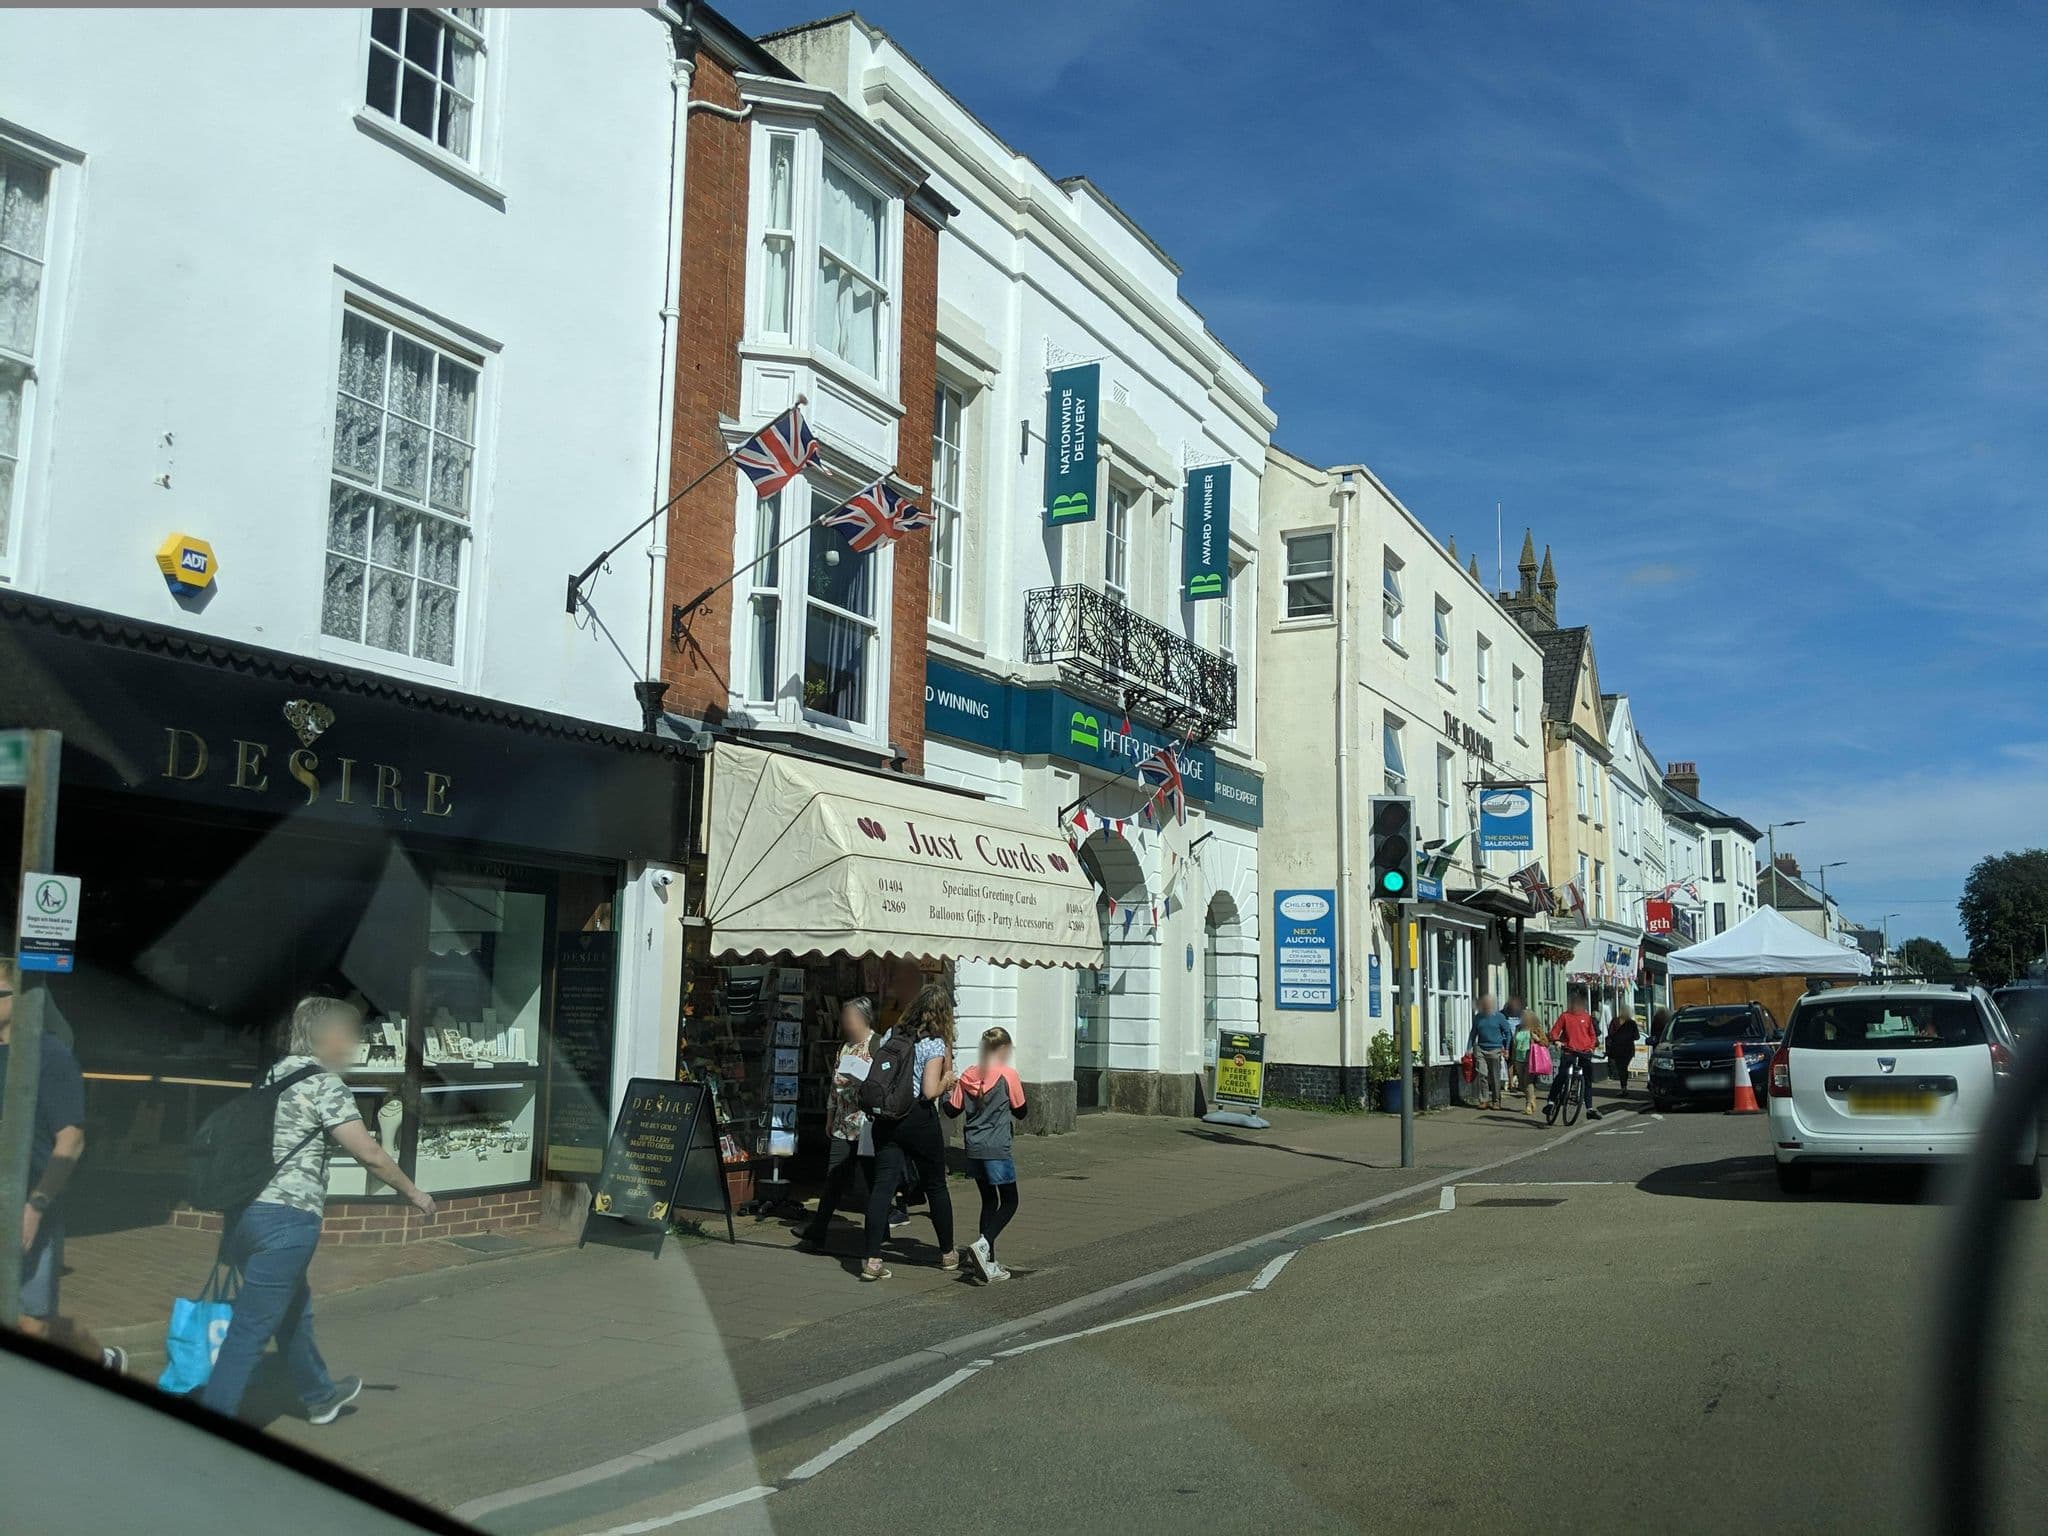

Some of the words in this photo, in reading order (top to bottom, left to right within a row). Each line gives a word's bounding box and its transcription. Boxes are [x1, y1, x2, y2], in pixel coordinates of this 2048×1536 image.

[1060, 388, 1073, 475] NATIONWIDE
[1074, 397, 1086, 462] DELIVERY
[1203, 474, 1214, 522] WINNER
[1201, 523, 1213, 566] AWARD
[182, 552, 208, 571] ADT
[937, 689, 989, 719] WINNING
[1443, 710, 1460, 743] THE
[1103, 728, 1140, 760] PETER
[161, 727, 454, 817] DESIRE
[1222, 783, 1235, 799] BED
[1235, 788, 1258, 807] EXPERT
[904, 821, 963, 861] Just
[975, 834, 1046, 875] Cards
[878, 877, 904, 894] 01404
[942, 880, 981, 898] Specialist
[982, 885, 1014, 906] Greeting
[1015, 890, 1037, 906] Cards
[881, 899, 906, 914] 42869
[929, 905, 965, 923] Balloons
[967, 909, 986, 927] Gifts
[993, 911, 1013, 929] Party
[1013, 915, 1054, 931] Accessories
[1649, 918, 1671, 932] gth
[1284, 936, 1326, 944] AUCTION
[1302, 990, 1328, 999] OCT
[1222, 1066, 1257, 1076] INTEREST
[1229, 1073, 1248, 1082] FREE
[1218, 1085, 1258, 1096] AVAILABLE
[1224, 1080, 1250, 1088] CREDIT
[632, 1097, 694, 1115] DESIRE
[660, 1123, 678, 1132] GOLD
